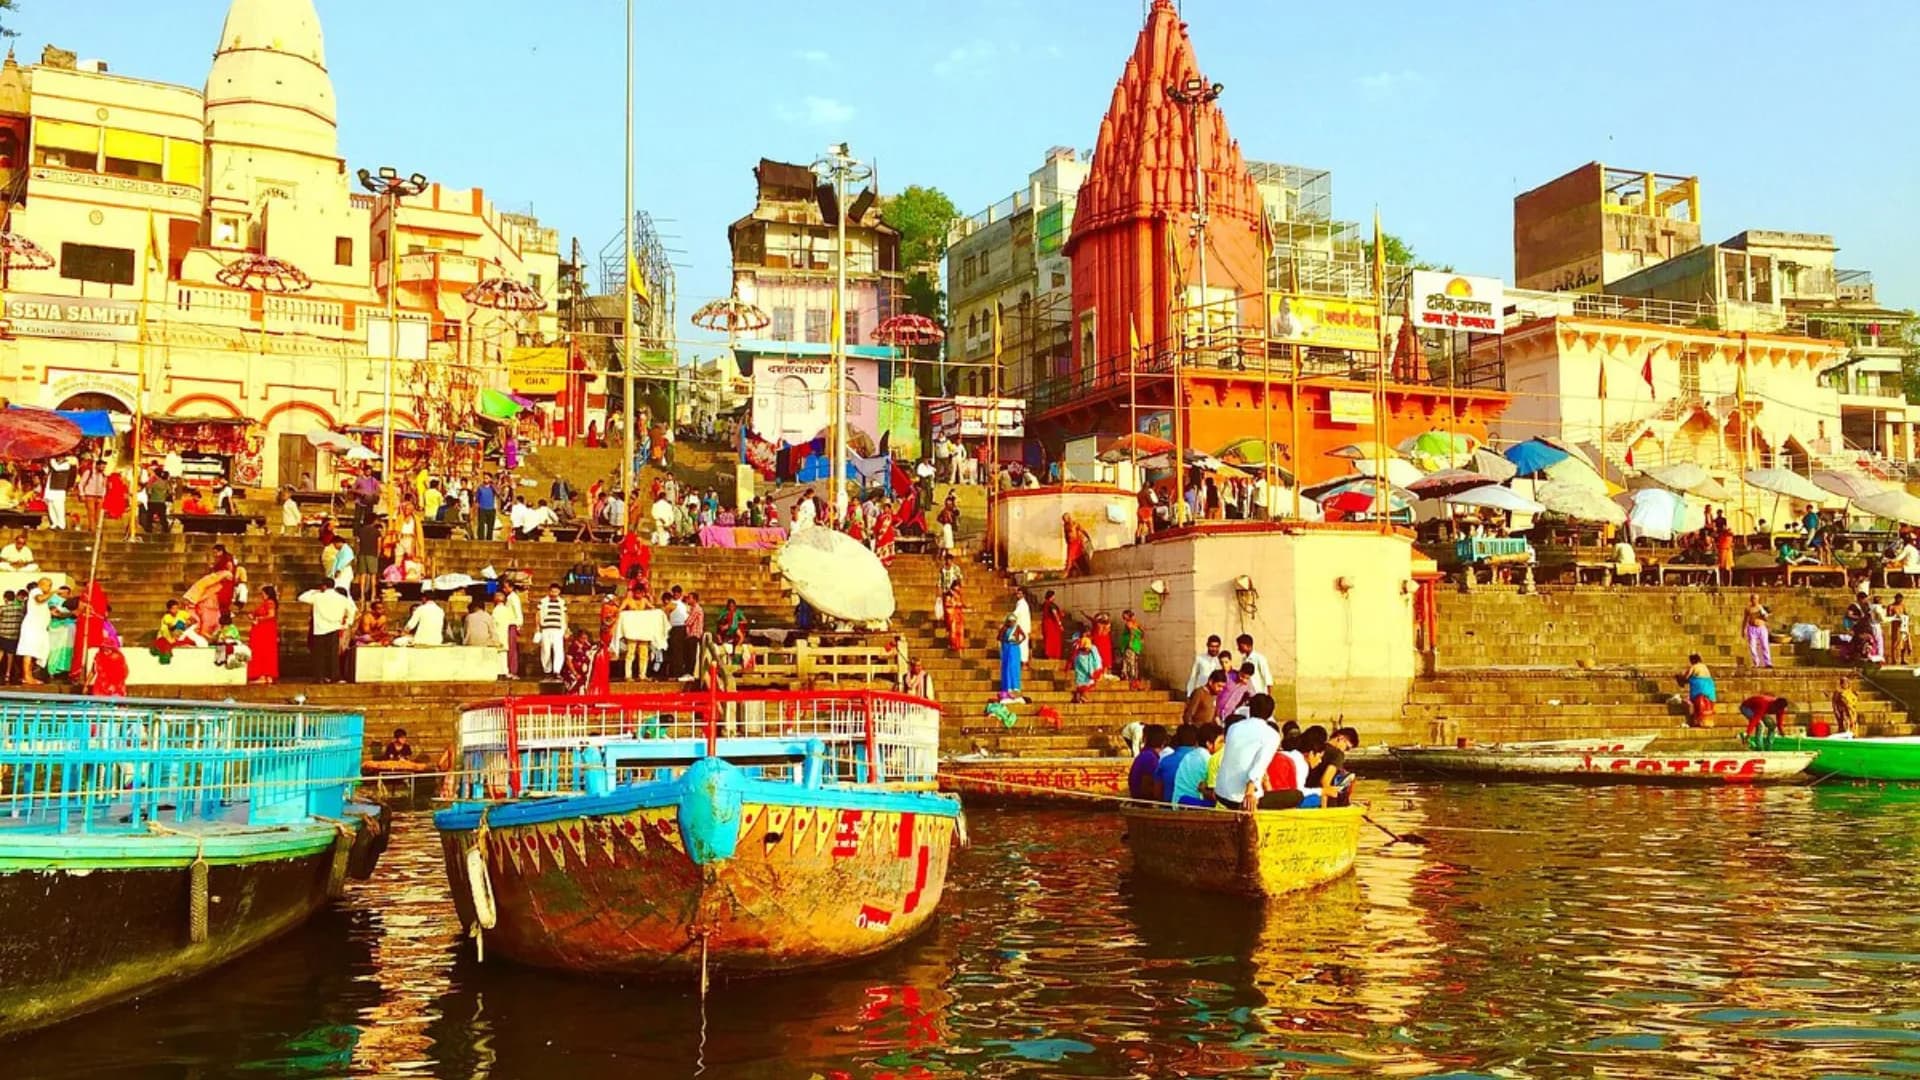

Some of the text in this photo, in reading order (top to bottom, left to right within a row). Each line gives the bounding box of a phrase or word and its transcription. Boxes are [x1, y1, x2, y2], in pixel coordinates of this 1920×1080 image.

[11, 302, 138, 325] SEVA SAMITI
[1426, 293, 1492, 315] दैनिक जागरण
